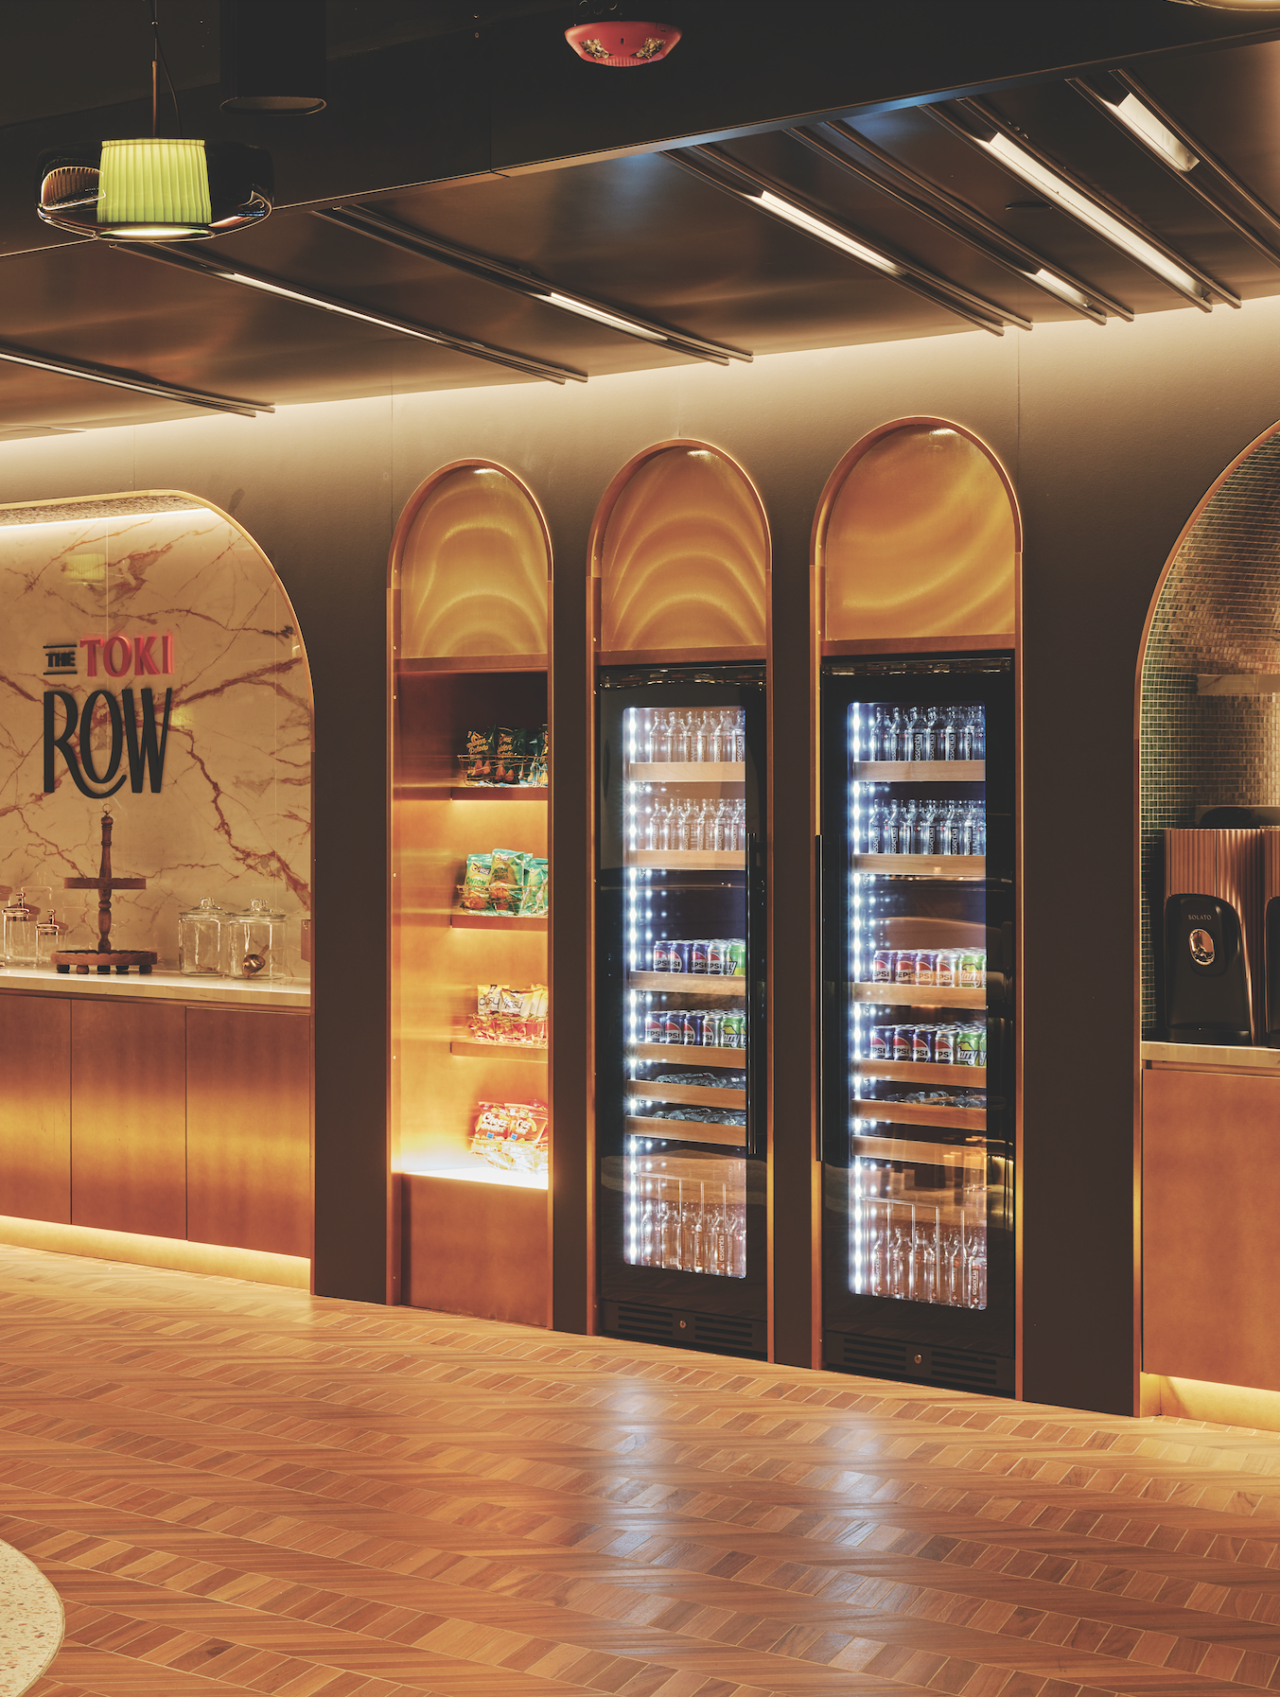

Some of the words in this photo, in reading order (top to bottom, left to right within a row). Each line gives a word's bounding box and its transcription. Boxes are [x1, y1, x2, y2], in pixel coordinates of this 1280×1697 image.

[45, 651, 76, 667] THE
[79, 635, 175, 678] TOKI
[43, 687, 173, 799] ROW
[874, 970, 890, 978] EPSI
[894, 1047, 910, 1055] EPSI
